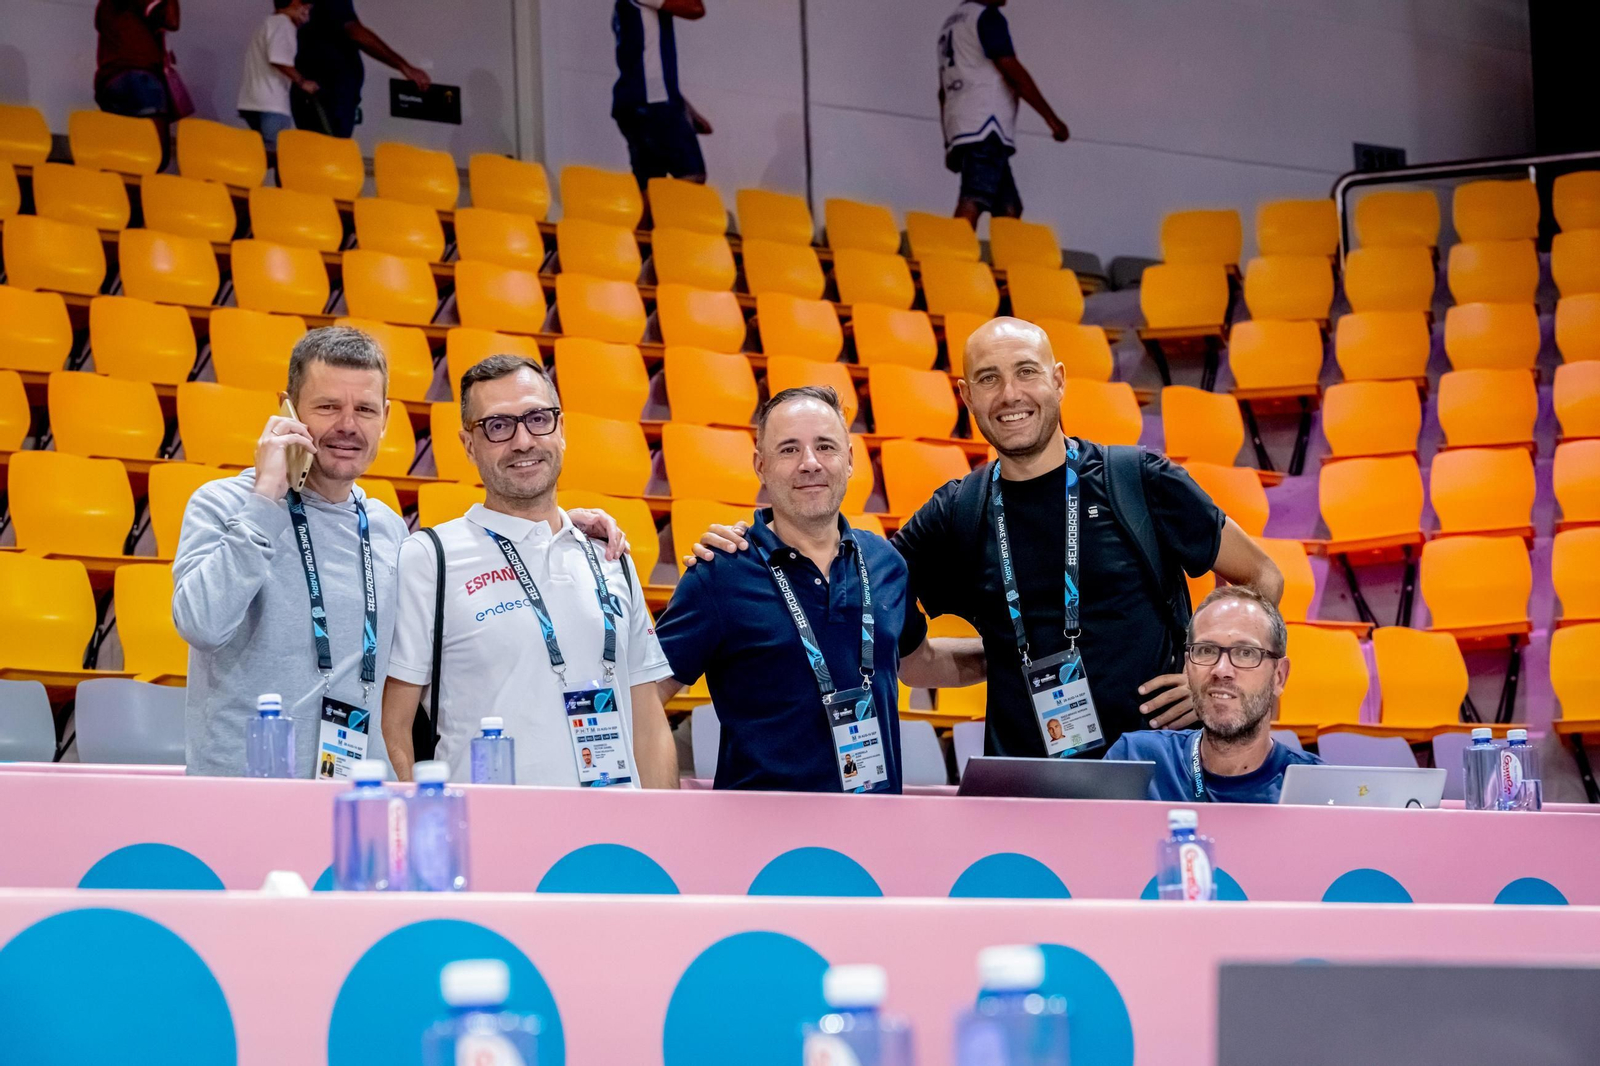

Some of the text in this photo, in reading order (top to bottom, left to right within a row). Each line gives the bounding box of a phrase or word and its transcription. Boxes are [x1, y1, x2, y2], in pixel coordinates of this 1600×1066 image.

[298, 526, 320, 596] MAKE YOUR MARK
[998, 516, 1013, 581] MAKE YOUR MARK
[1068, 494, 1077, 566] #EUROBASKET
[363, 538, 376, 612] #EUROBASKET
[465, 566, 519, 596] ESPAÑ
[498, 539, 540, 601] #EUROBASKET
[771, 565, 808, 629] #EUROBASKET
[1195, 773, 1204, 795] MARK
